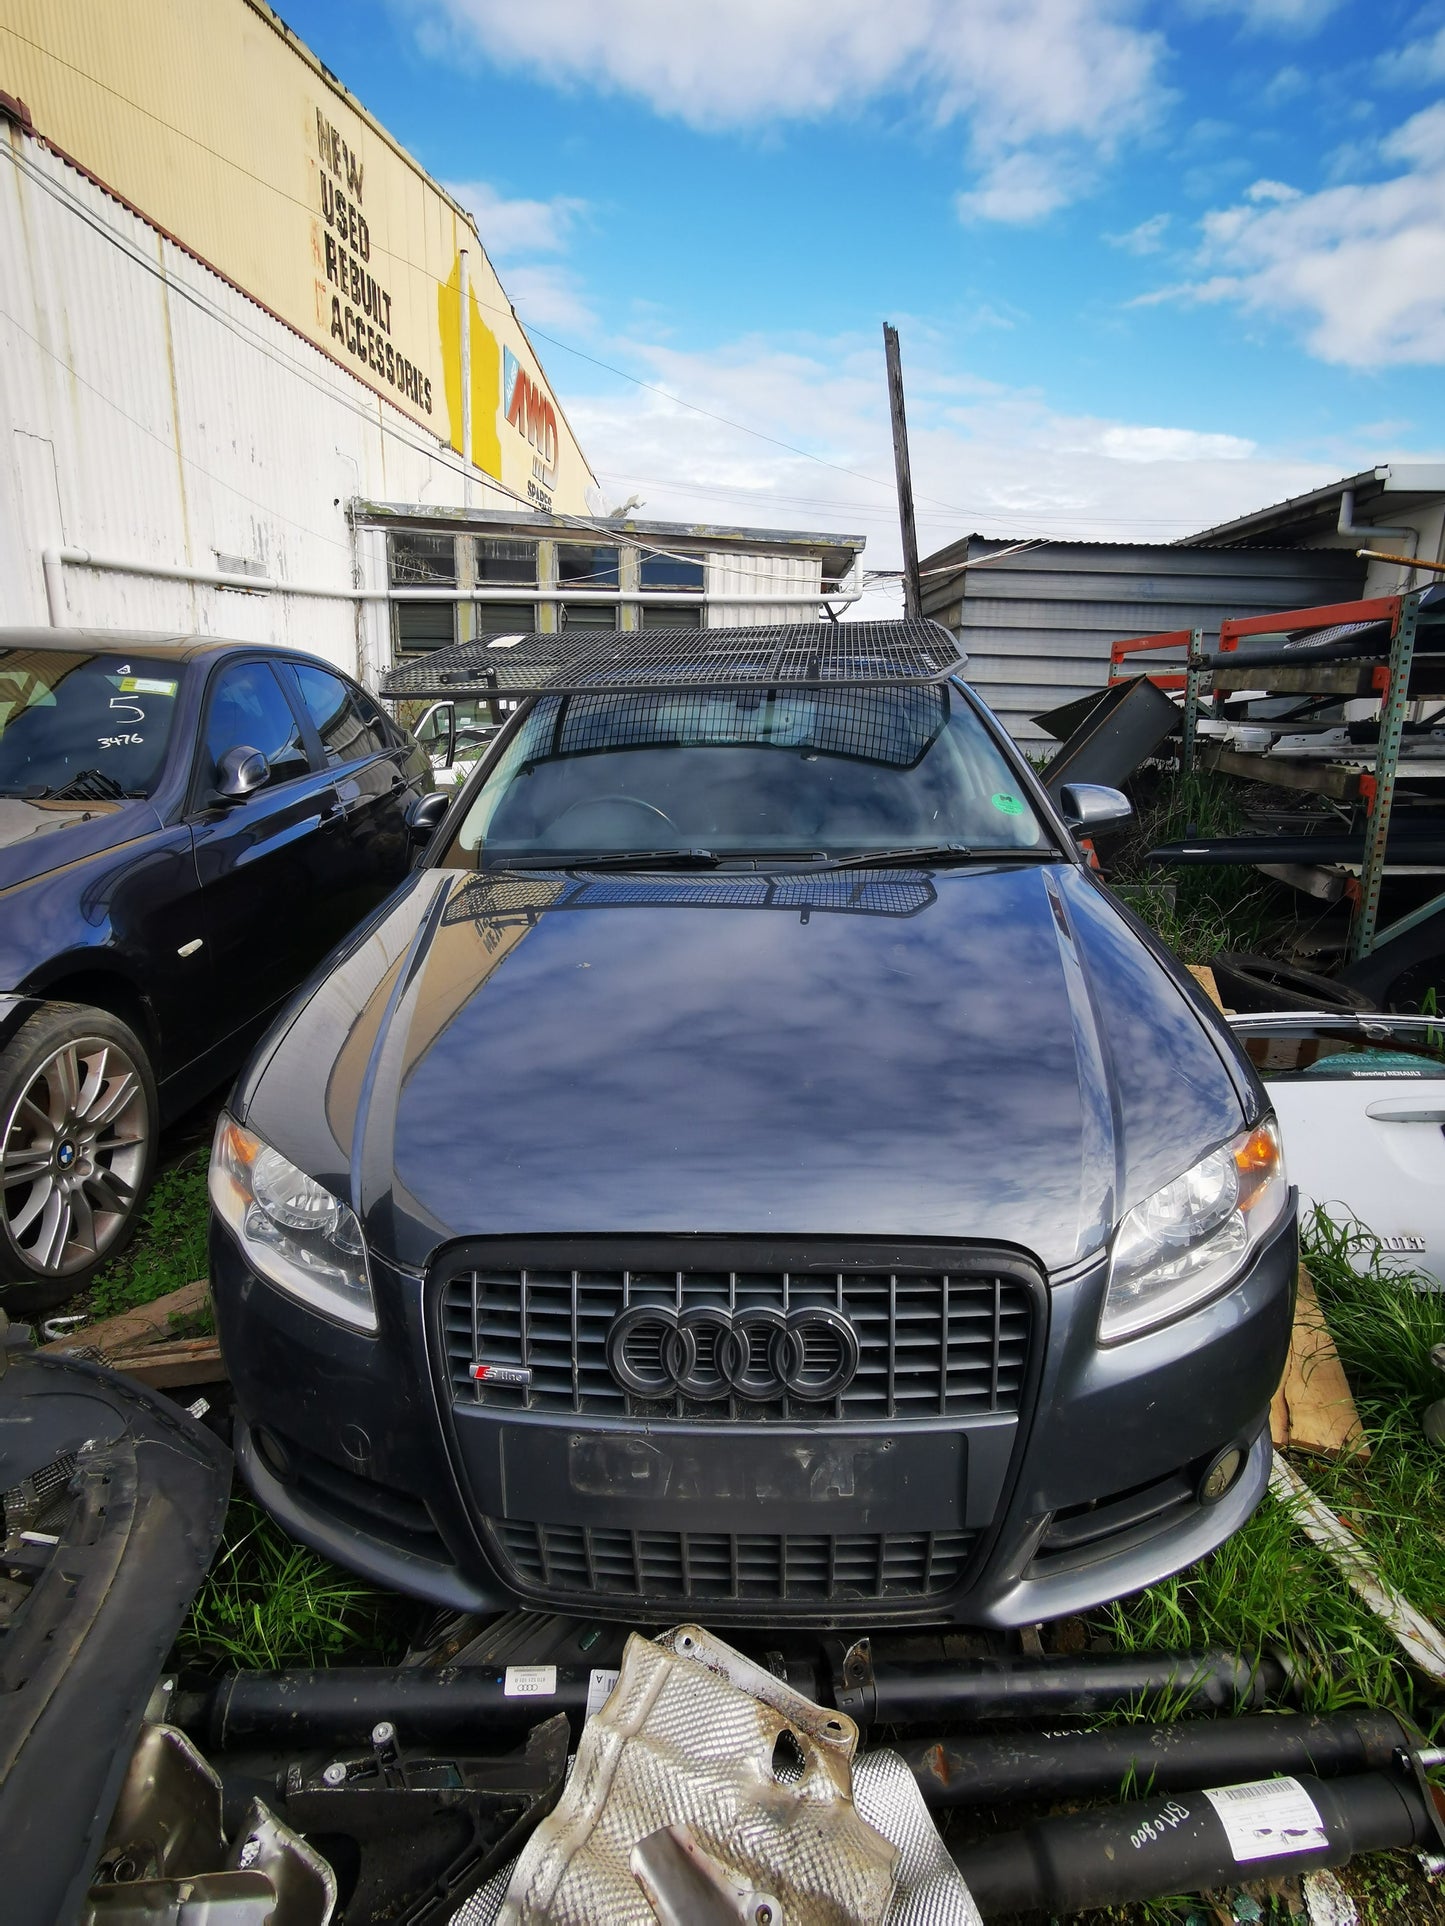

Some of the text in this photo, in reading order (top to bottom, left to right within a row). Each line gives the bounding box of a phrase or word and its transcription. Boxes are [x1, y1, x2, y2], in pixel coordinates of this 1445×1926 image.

[316, 106, 363, 206] NEW
[320, 169, 370, 263] USED
[324, 231, 391, 335] REBUILT
[331, 295, 432, 415] ACCESSORIES
[97, 733, 144, 749] 3476
[109, 695, 145, 724] 5
